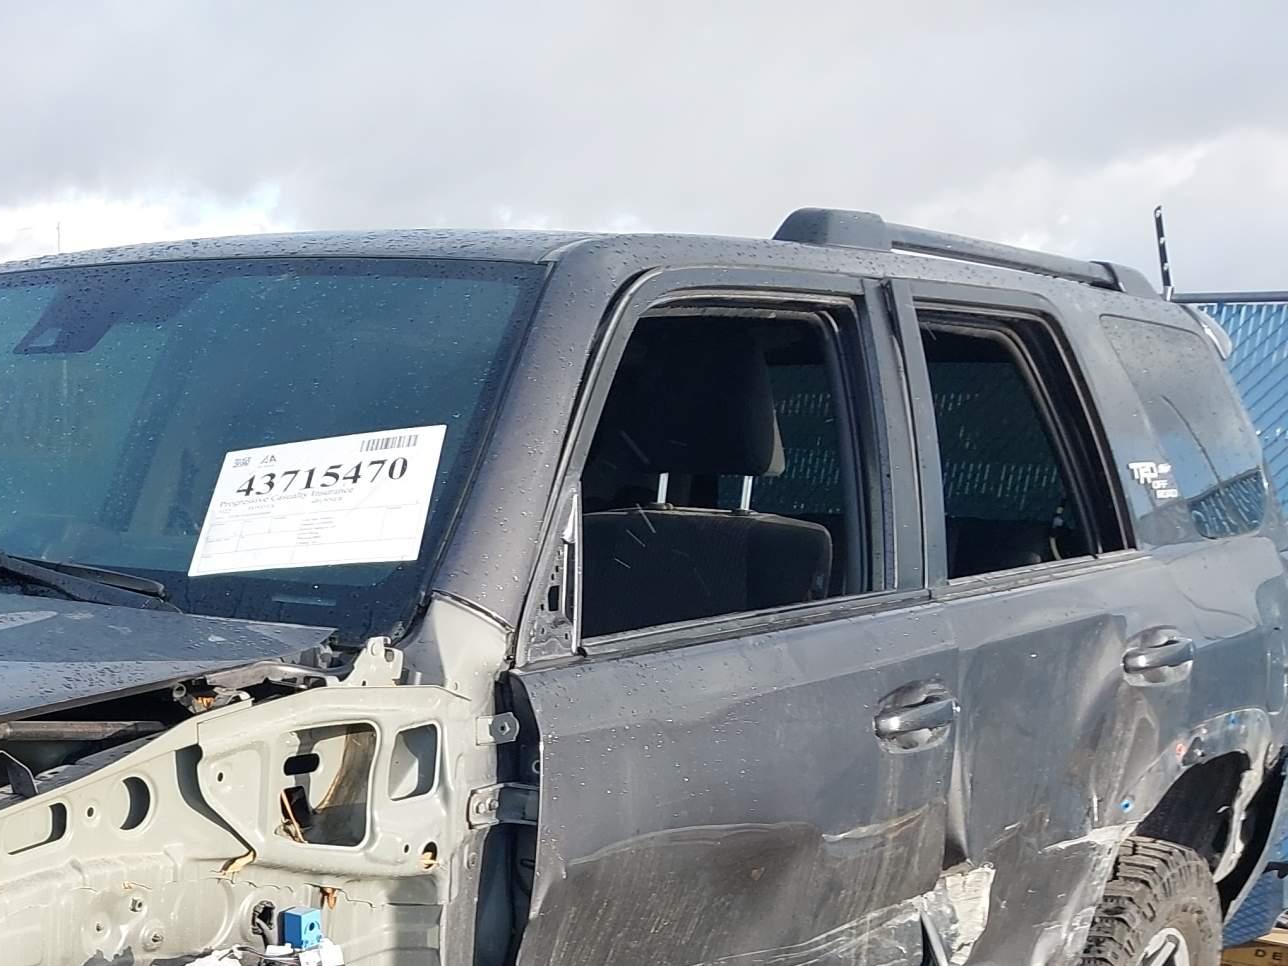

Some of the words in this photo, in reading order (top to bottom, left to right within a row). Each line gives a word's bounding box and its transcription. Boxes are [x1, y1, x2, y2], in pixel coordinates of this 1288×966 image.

[236, 457, 408, 497] 43715470
[1128, 462, 1158, 485] TRD
[311, 487, 355, 497] Insurance
[1254, 948, 1288, 961] DE
